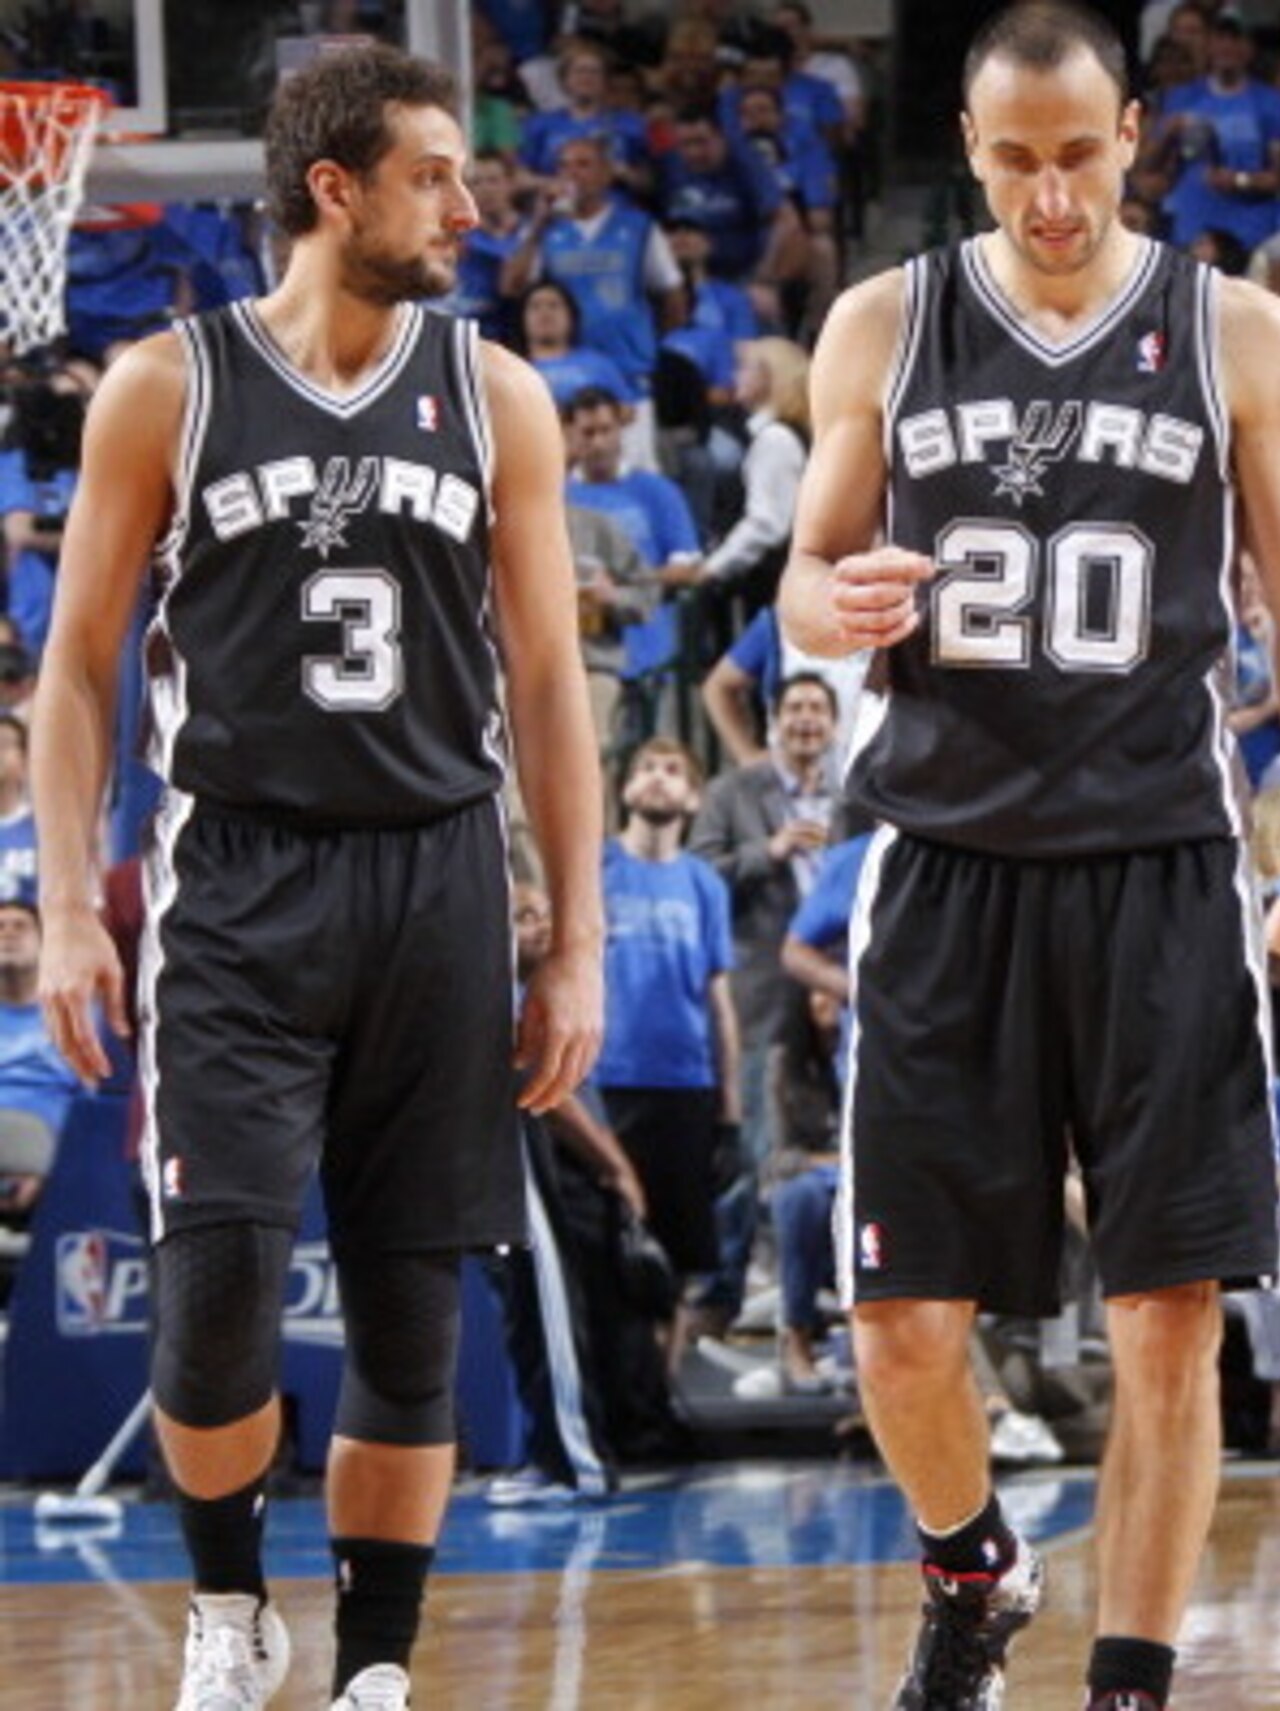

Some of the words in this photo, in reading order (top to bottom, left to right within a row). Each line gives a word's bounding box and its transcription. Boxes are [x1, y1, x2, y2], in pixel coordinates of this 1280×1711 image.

[202, 456, 479, 558] SPURS
[897, 398, 1204, 506] SPURS
[301, 567, 405, 711] 3
[930, 516, 1156, 673] 20
